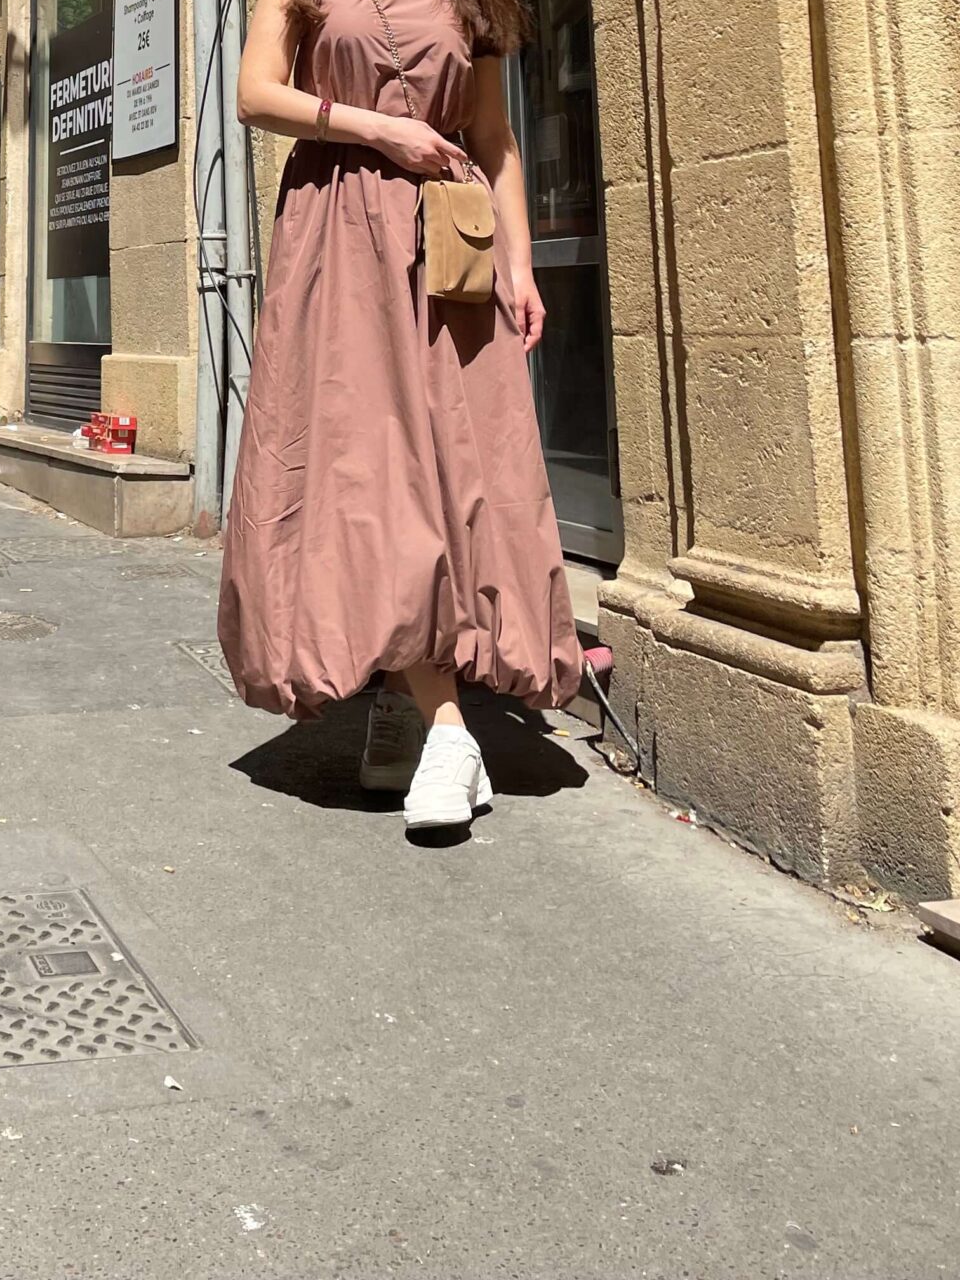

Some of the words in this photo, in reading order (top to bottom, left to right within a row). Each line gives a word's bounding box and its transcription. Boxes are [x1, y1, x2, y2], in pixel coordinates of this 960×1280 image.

[138, 9, 154, 24] Coiffage
[138, 29, 150, 51] 25€
[132, 65, 153, 85] HORAIRES
[53, 95, 112, 143] DEFINITIVE
